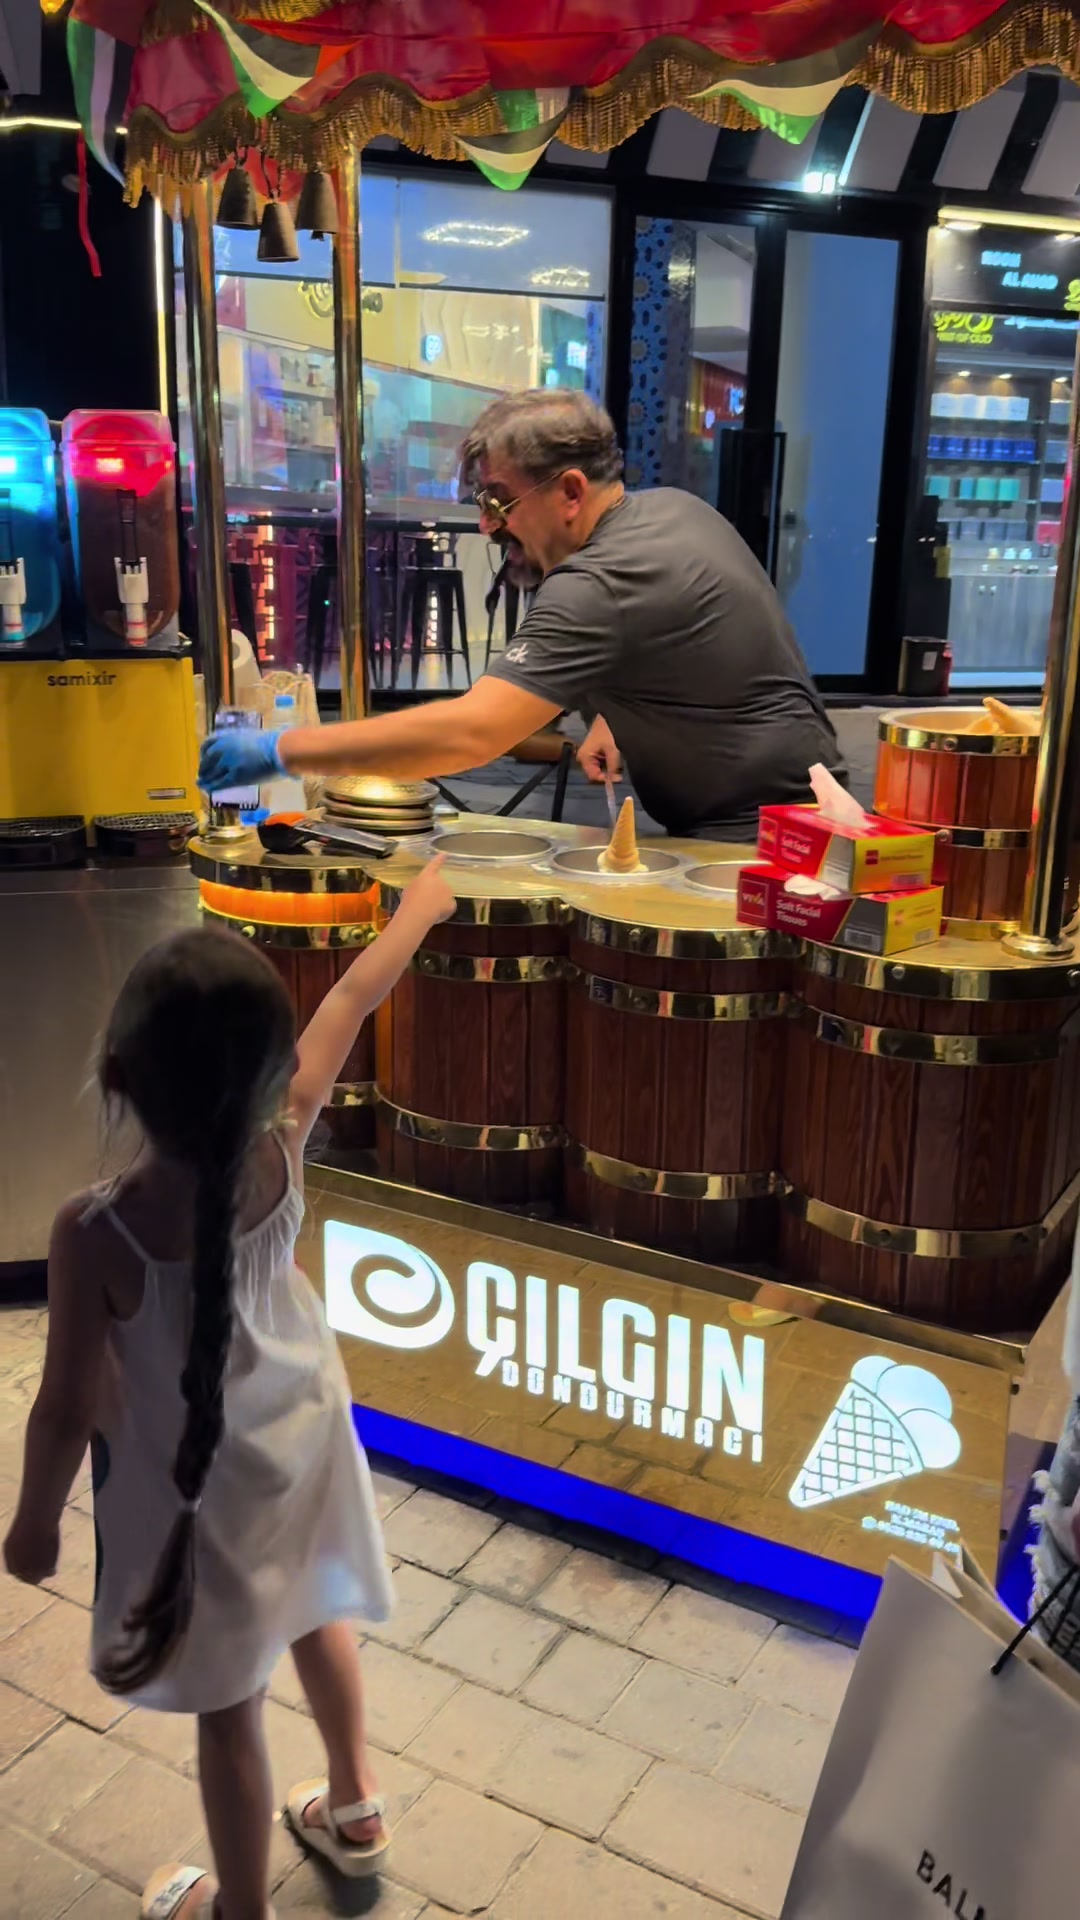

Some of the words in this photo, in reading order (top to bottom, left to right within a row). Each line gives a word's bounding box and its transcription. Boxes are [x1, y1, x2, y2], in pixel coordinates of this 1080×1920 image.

[47, 671, 116, 686] samixir
[776, 899, 794, 912] Soft
[795, 904, 821, 918] Facial
[776, 910, 808, 926] Tissues
[466, 1261, 765, 1433] ÇILGIN
[502, 1359, 763, 1463] DONDURMACI
